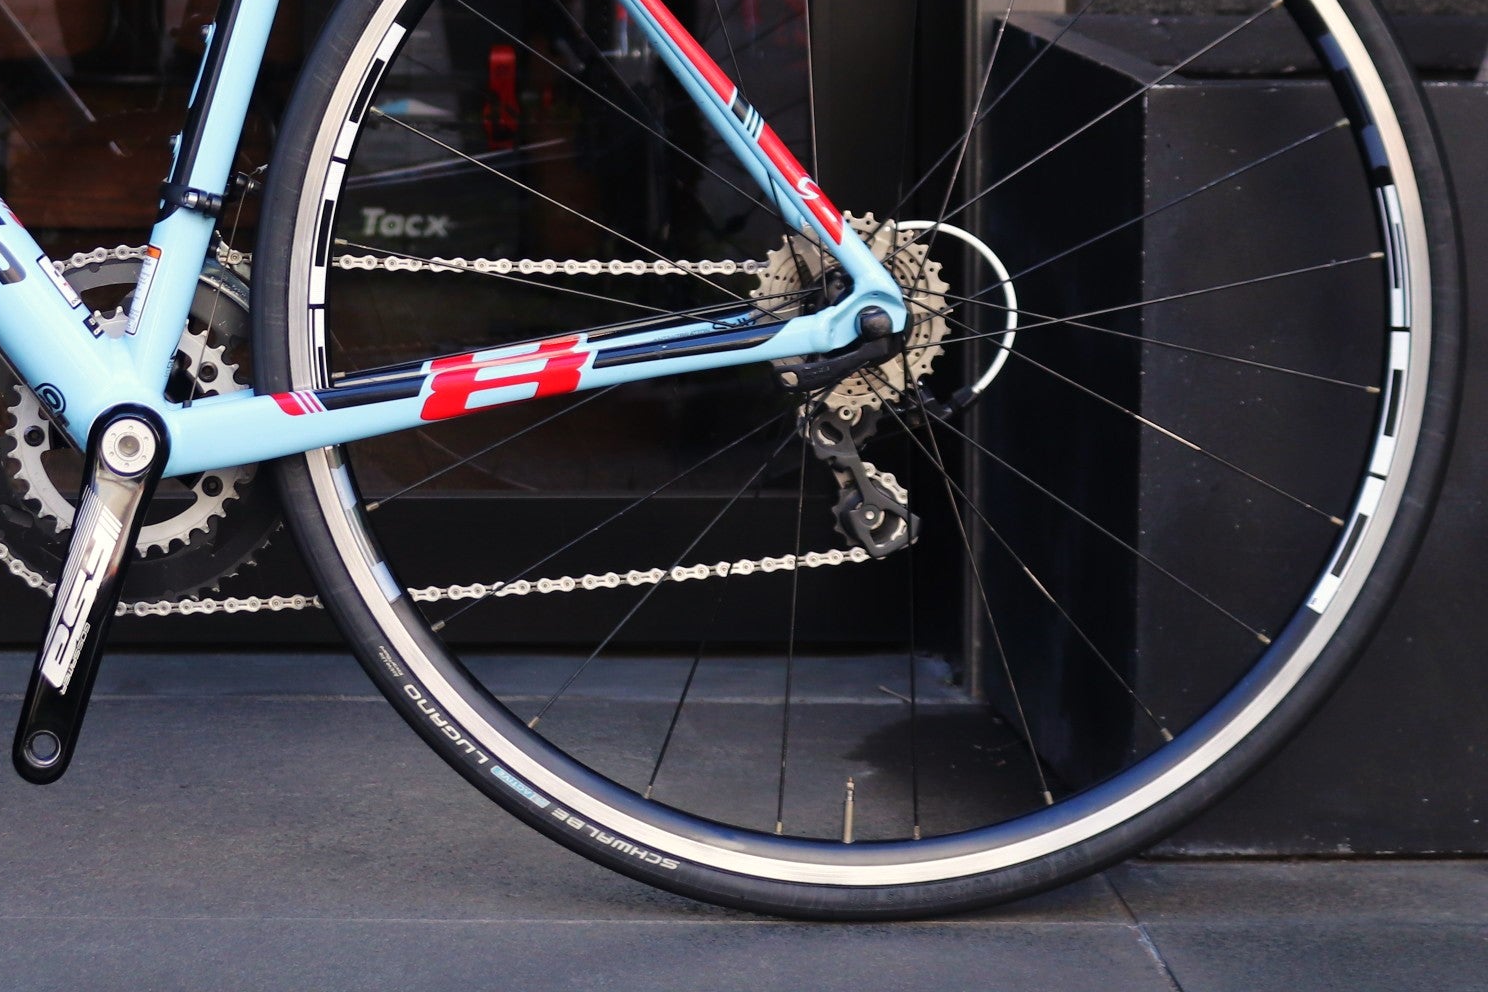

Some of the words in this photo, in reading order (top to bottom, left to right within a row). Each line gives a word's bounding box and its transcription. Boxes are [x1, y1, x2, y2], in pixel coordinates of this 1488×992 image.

[362, 207, 450, 238] Tacx
[403, 684, 490, 766] LUGANO
[551, 807, 681, 871] SCHWALBE
